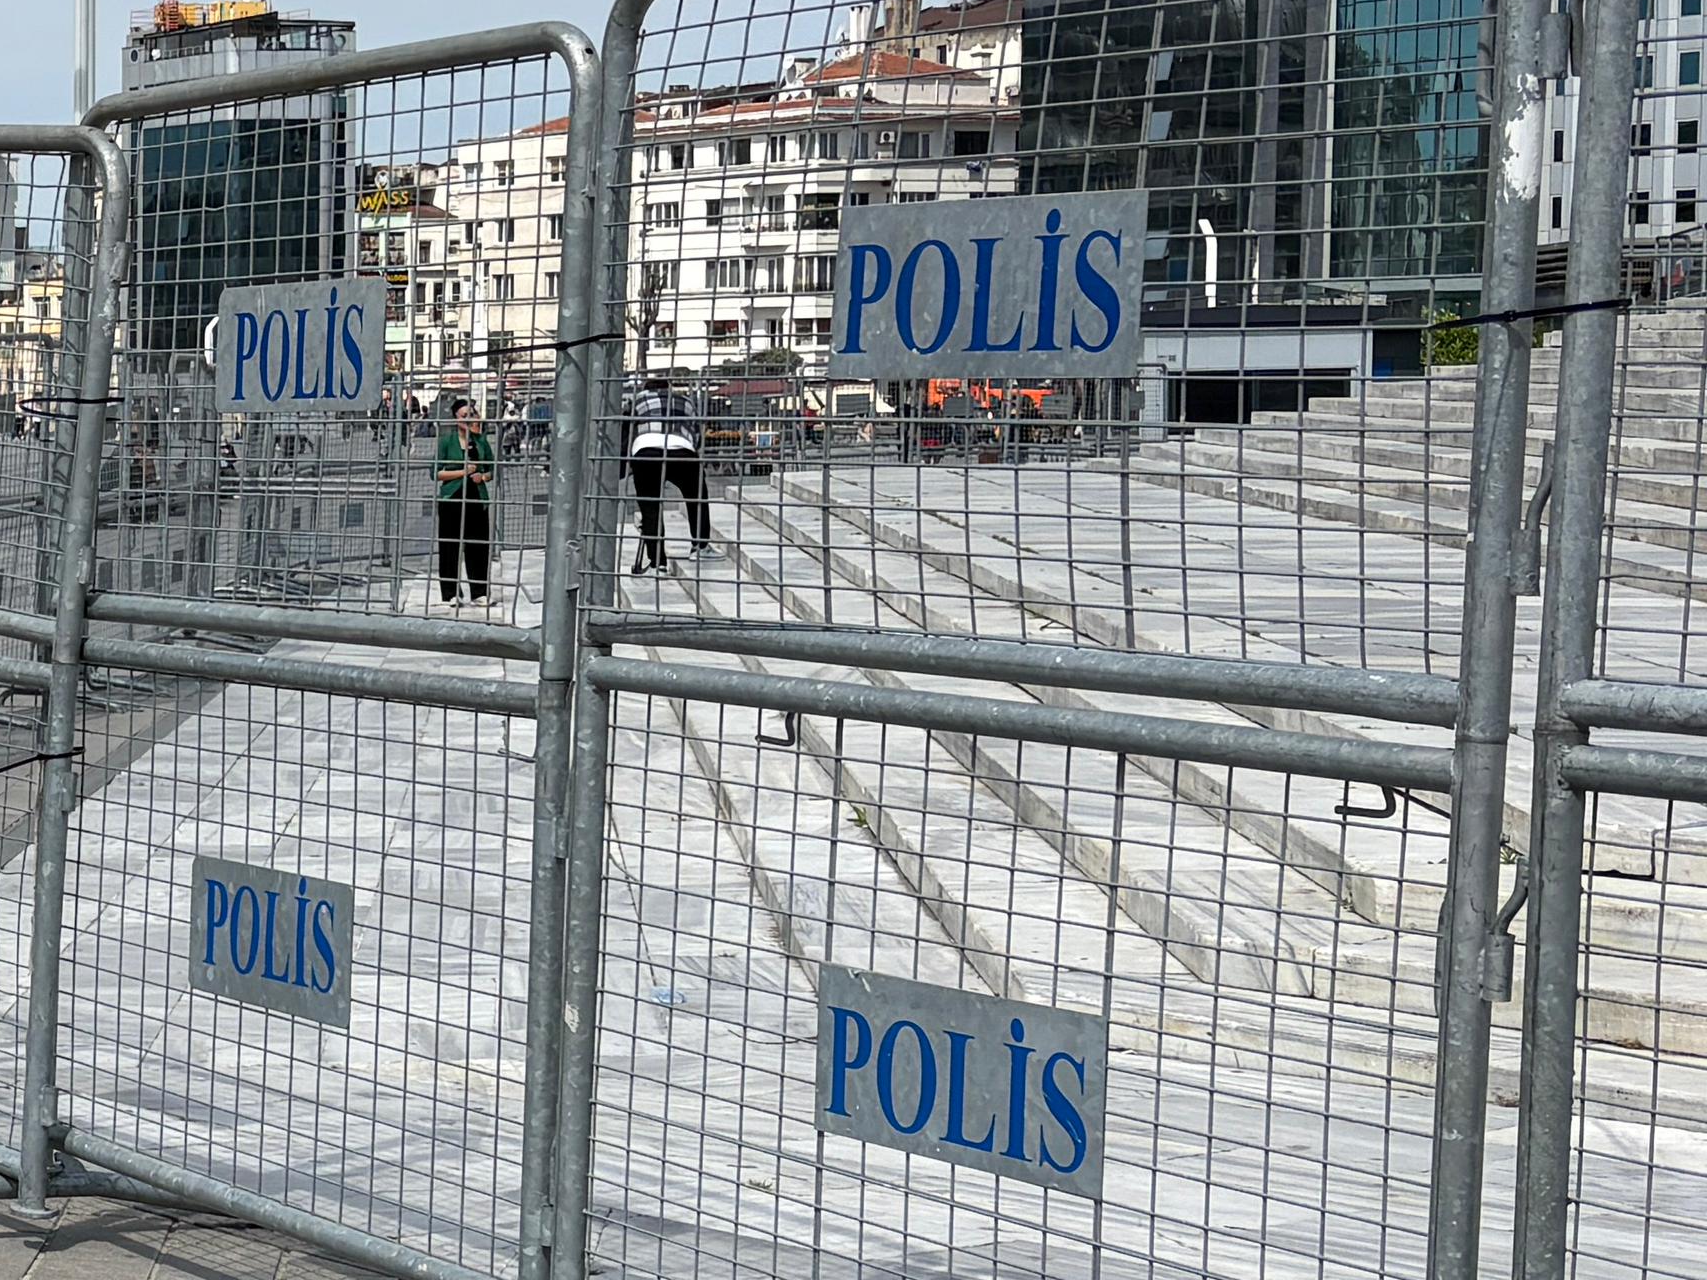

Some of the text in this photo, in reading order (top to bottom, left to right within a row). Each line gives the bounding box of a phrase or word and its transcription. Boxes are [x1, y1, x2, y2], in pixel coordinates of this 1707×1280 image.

[231, 286, 364, 402] POLİS
[837, 208, 1122, 355] POLİS
[203, 877, 337, 994] POLİS
[822, 1005, 1087, 1174] POLİS
